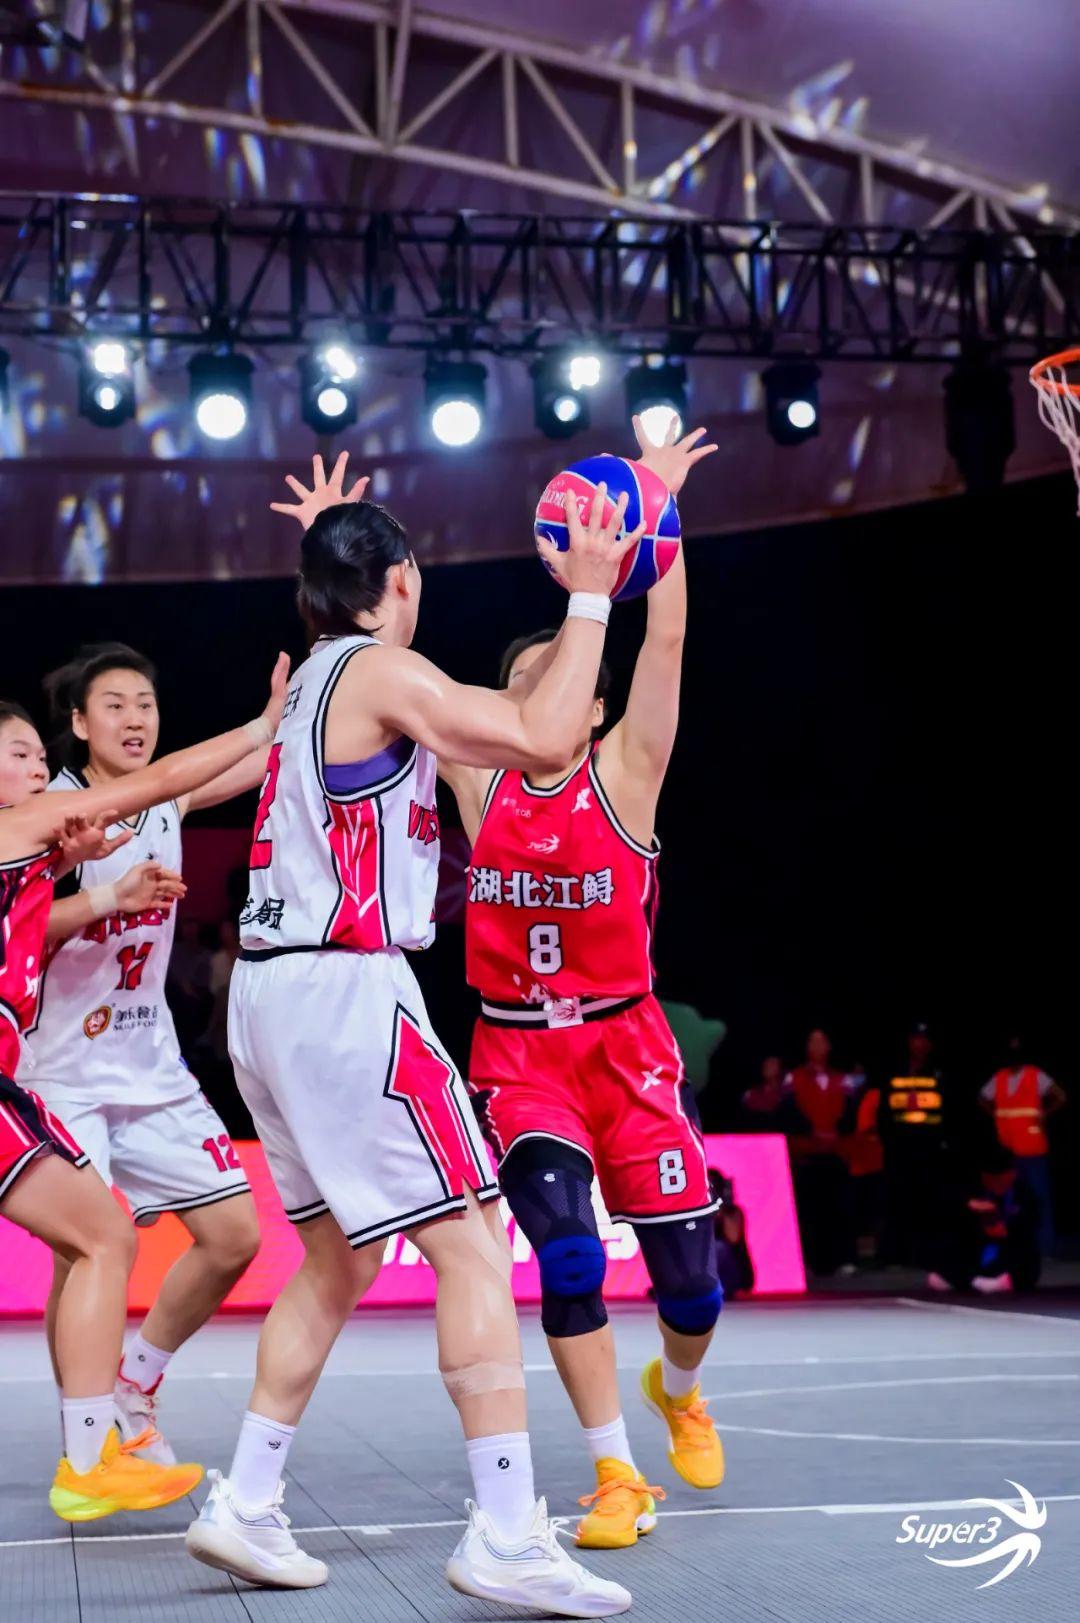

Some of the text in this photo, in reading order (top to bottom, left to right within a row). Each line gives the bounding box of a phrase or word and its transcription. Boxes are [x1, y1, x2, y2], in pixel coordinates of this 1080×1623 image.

[467, 867, 614, 908] 湖北江鲟
[528, 923, 563, 975] 8
[202, 1134, 241, 1172] 12
[657, 1148, 688, 1195] 8
